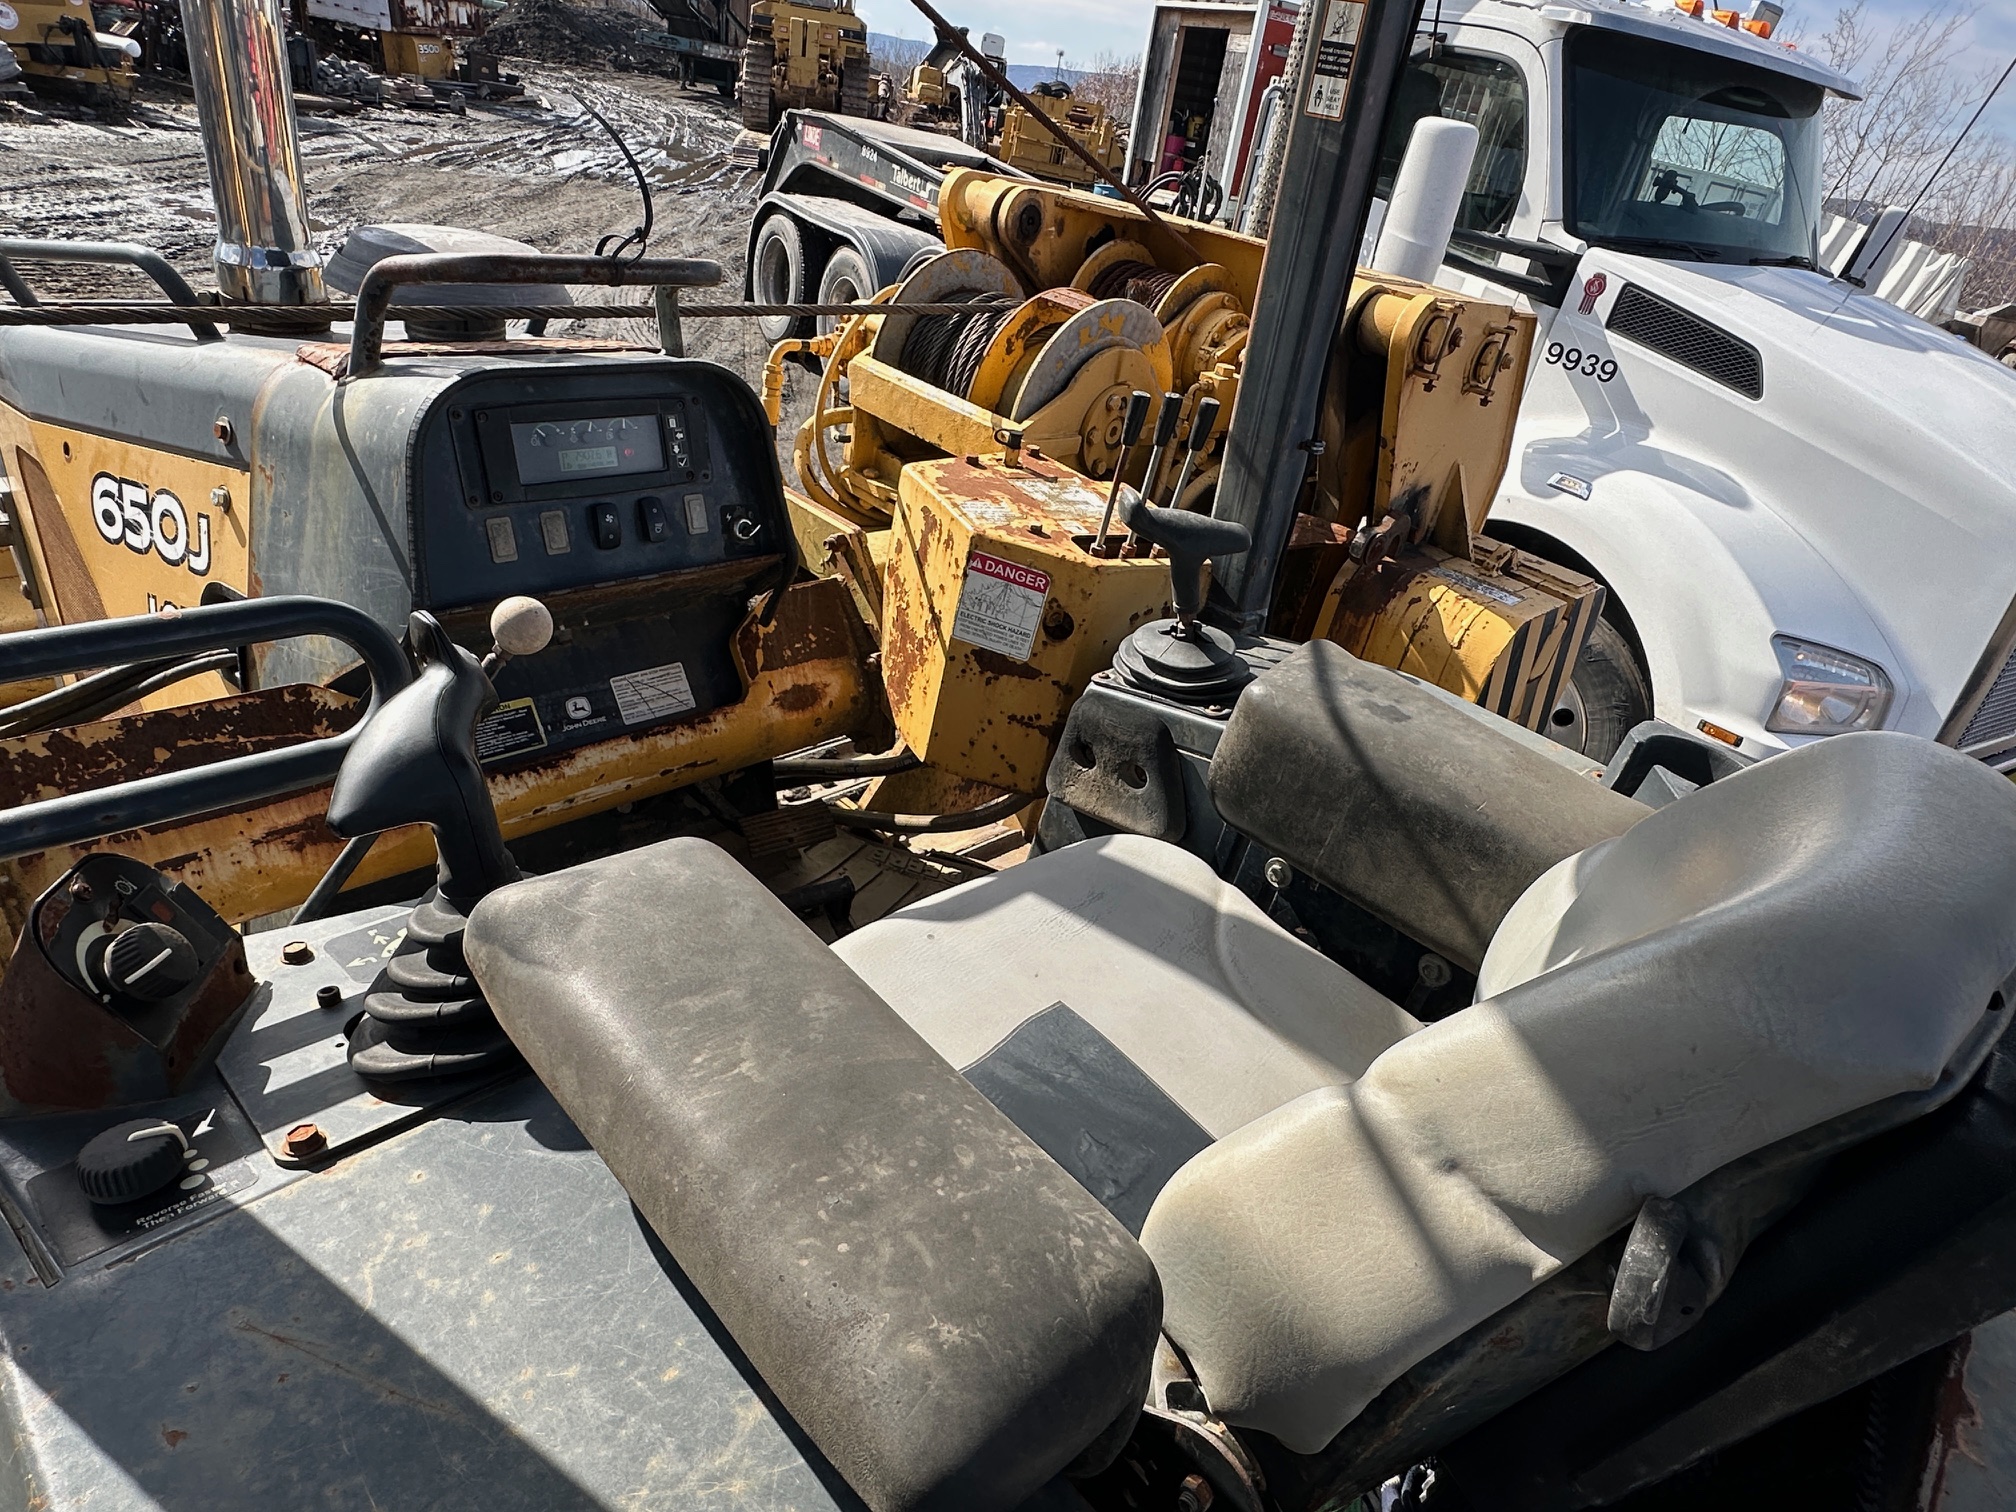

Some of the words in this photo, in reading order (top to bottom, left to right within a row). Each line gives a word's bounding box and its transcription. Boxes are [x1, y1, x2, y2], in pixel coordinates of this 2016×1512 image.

[892, 164, 922, 192] Talbert
[1545, 342, 1618, 382] 9939
[91, 471, 211, 577] 650J
[984, 560, 1046, 590] DANGER
[960, 611, 987, 624] ELECTRIC
[987, 621, 1007, 631] SHOCK
[1007, 627, 1031, 639] HAZARD
[562, 719, 582, 732] JOHN
[582, 716, 606, 726] DEERE
[136, 1200, 186, 1225] Reverse
[190, 1182, 227, 1201] Faster
[142, 1214, 174, 1228] Then
[177, 1188, 228, 1214] Forward
